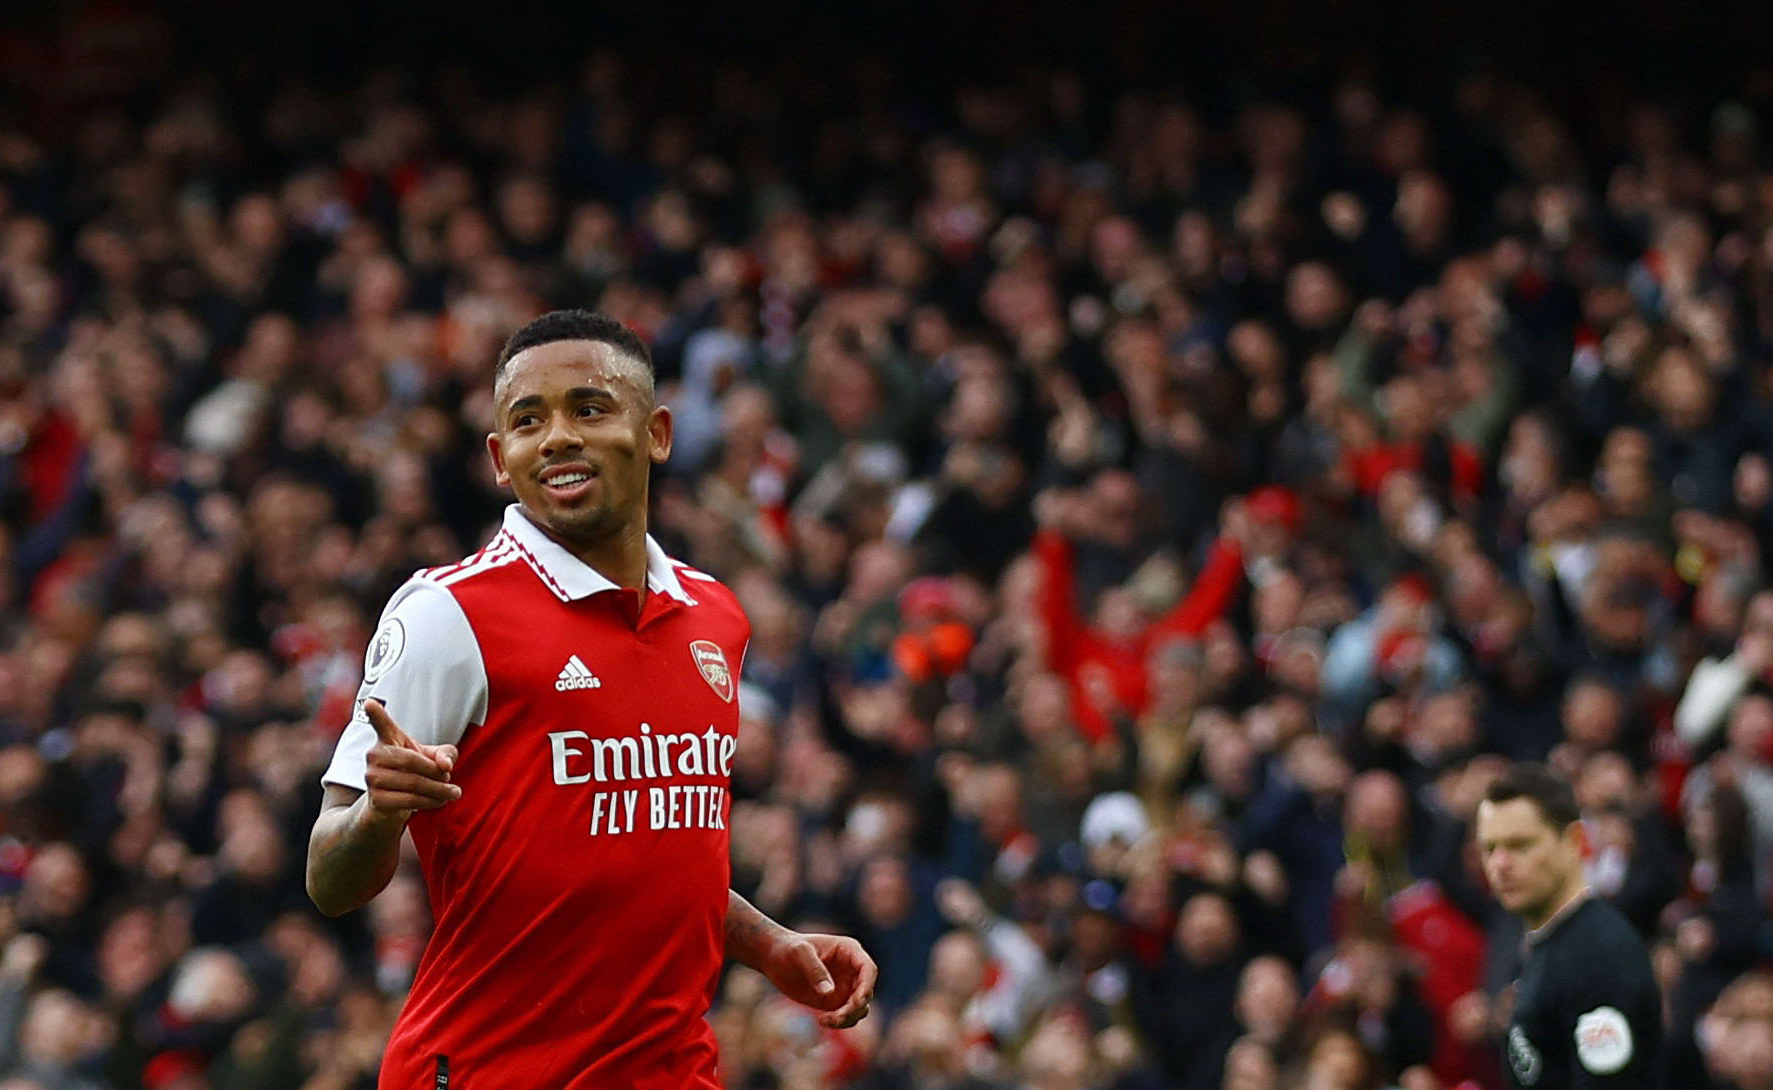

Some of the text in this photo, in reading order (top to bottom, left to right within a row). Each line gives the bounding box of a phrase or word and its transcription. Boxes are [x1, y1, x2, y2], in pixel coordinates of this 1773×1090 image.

[555, 676, 602, 692] adidas
[547, 722, 738, 786] Emirate
[590, 791, 639, 836] FLY
